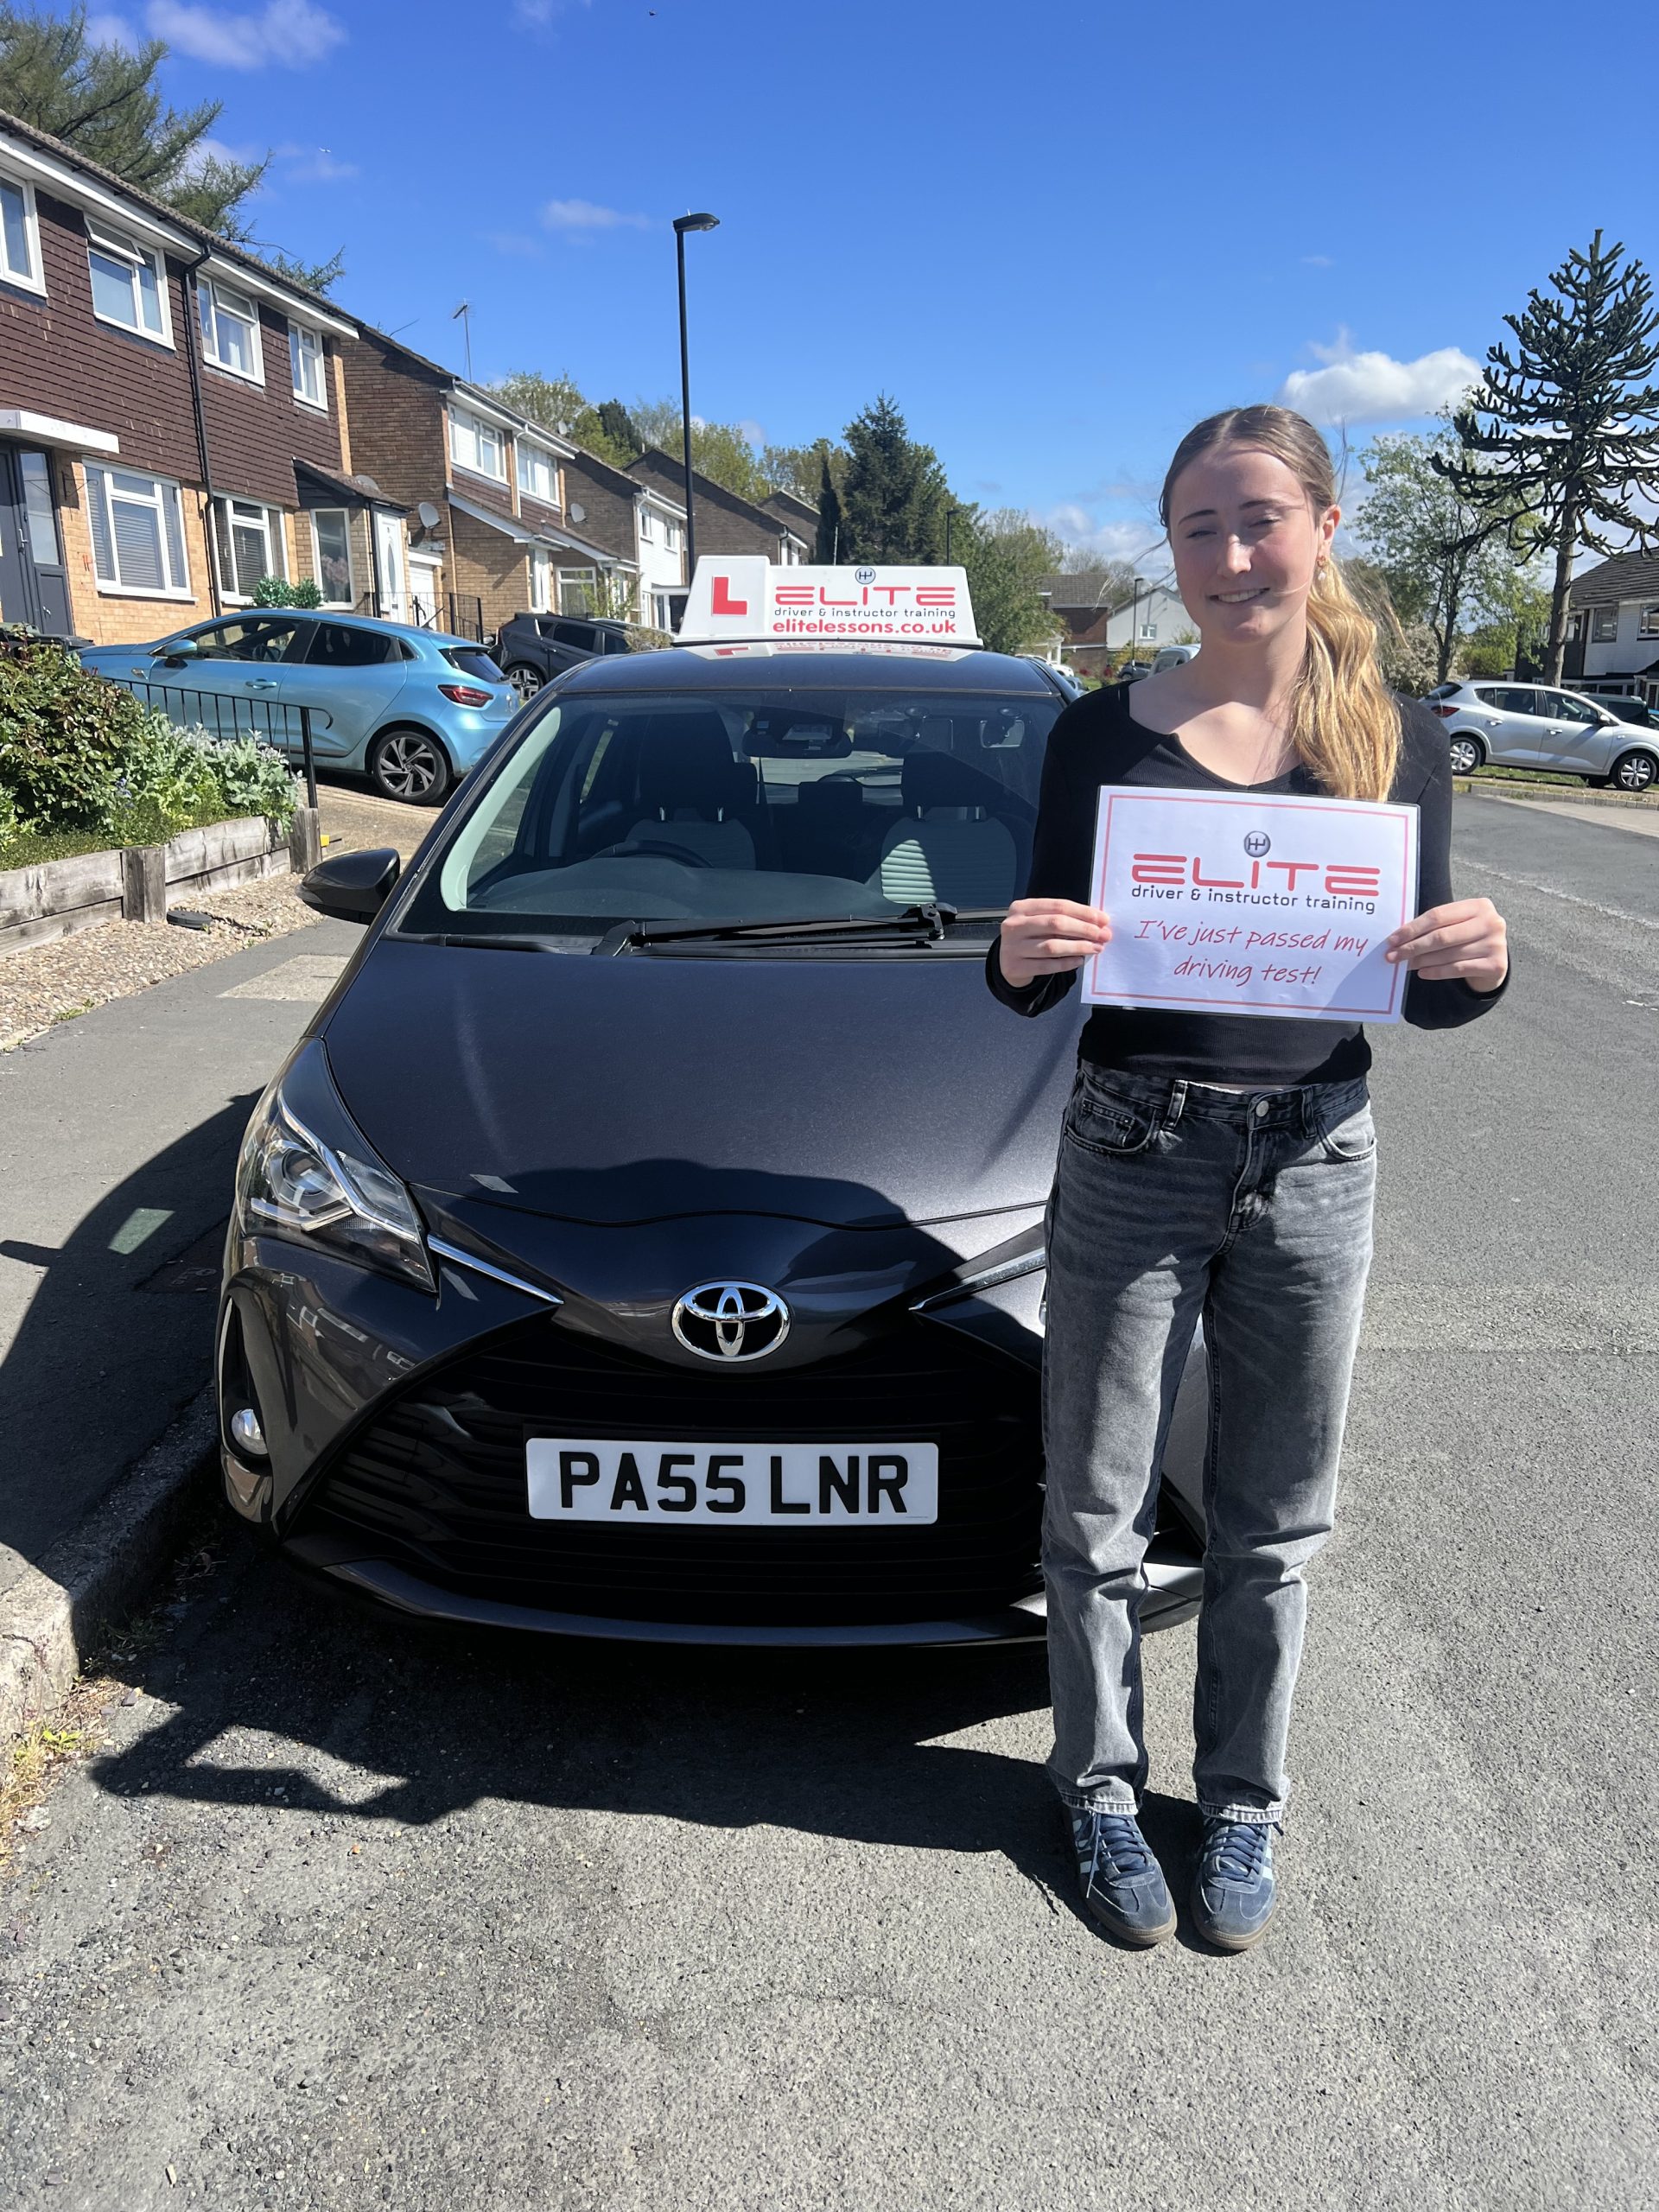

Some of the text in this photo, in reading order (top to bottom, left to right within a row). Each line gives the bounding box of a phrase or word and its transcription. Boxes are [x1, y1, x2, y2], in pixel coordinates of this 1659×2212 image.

[712, 576, 747, 615] L
[772, 618, 957, 634] elitelessons.co.uk
[774, 607, 956, 619] driver & instructor training
[1131, 884, 1376, 915] driver & instructor training
[1134, 919, 1369, 957] I've just passed my
[1173, 956, 1322, 987] driving test!
[560, 1452, 908, 1514] PA55 LNR
